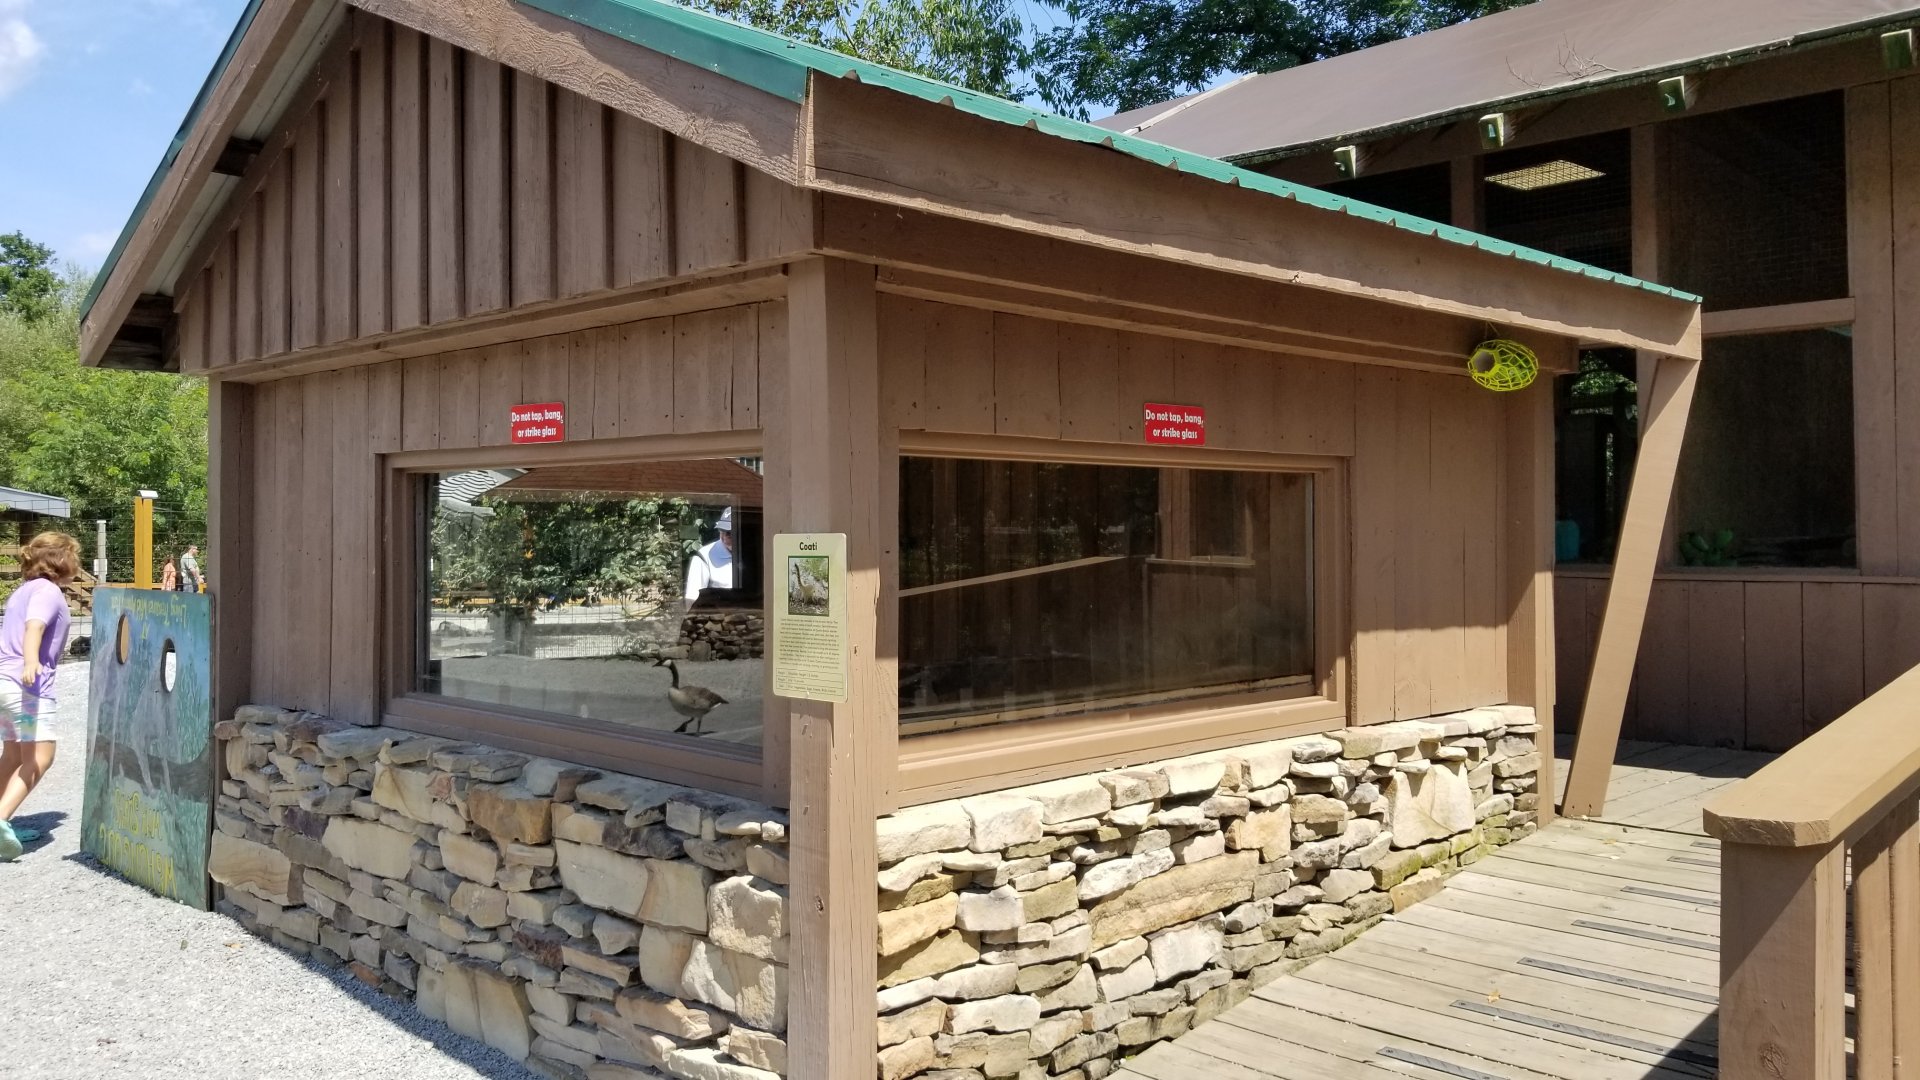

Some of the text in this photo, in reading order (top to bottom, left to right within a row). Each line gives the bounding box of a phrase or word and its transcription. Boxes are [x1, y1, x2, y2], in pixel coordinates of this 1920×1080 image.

[511, 409, 563, 422] Do not tap, bang,
[1145, 409, 1204, 425] Do not tap, bang,
[517, 425, 557, 438] or strike glass
[1152, 427, 1198, 440] or strike glass
[799, 541, 818, 551] Coati
